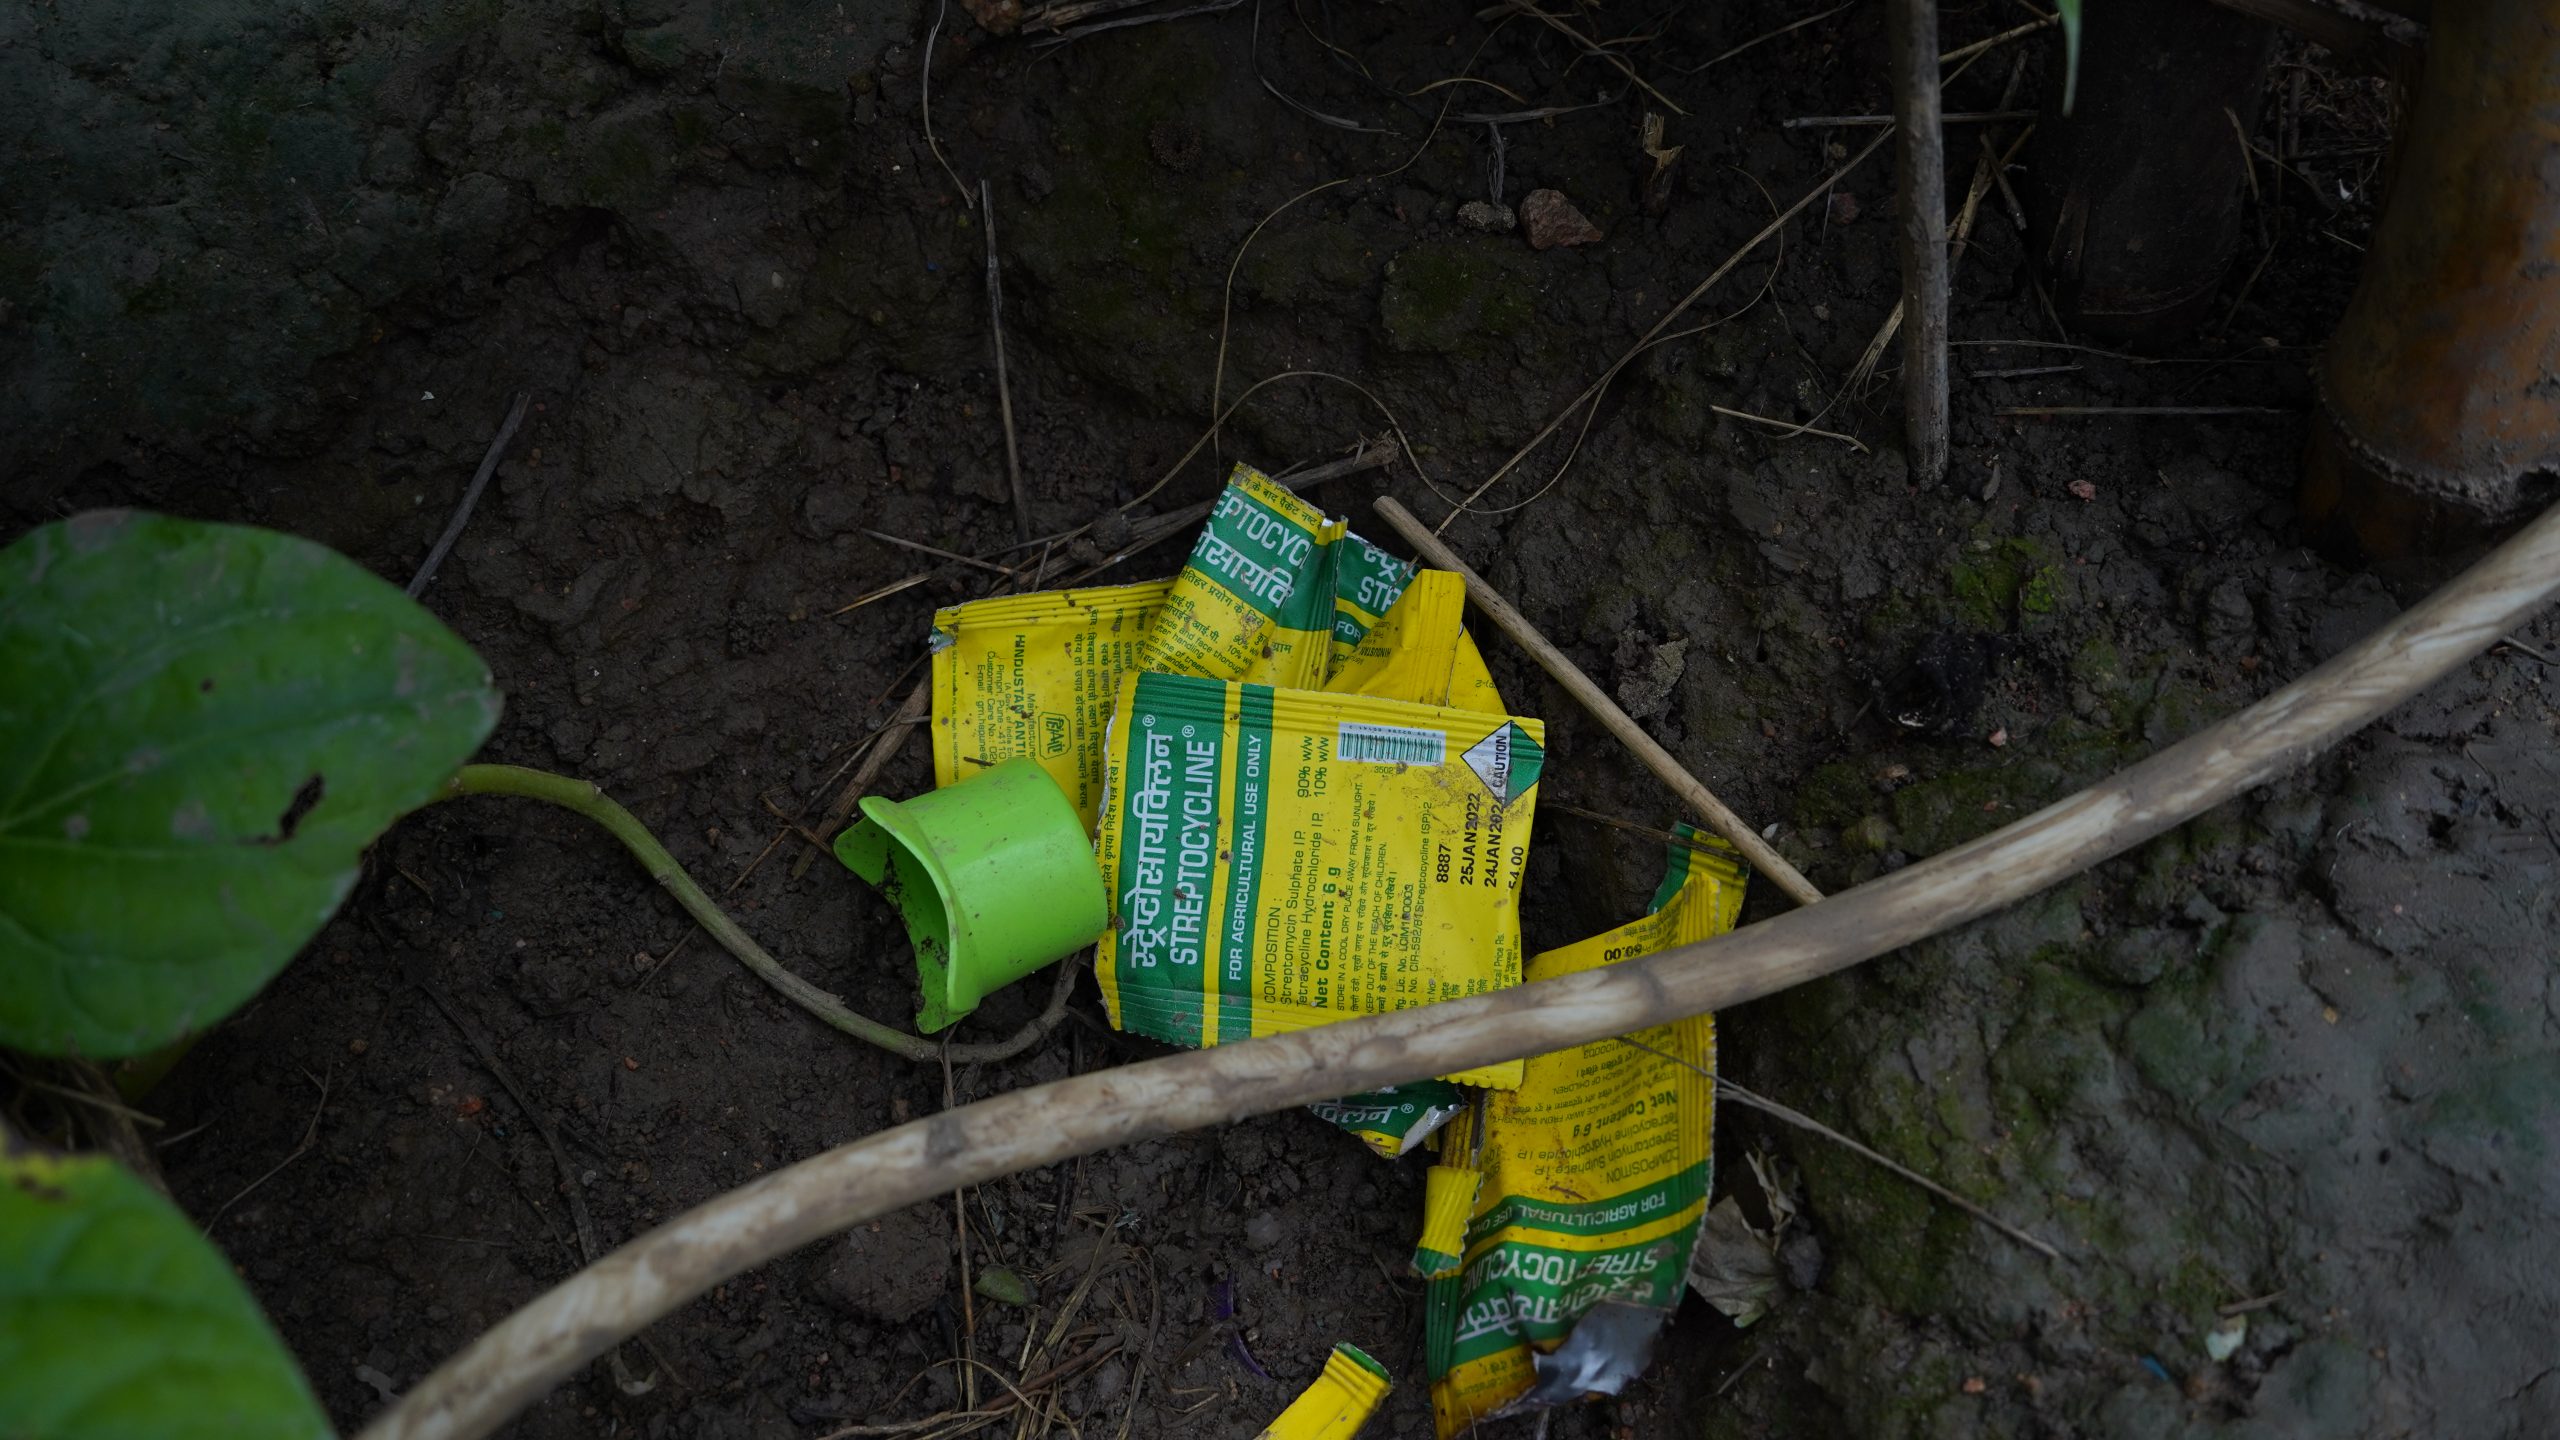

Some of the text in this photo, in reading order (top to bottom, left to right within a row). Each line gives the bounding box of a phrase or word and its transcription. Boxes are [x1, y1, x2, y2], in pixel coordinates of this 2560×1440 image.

[1299, 735, 1313, 761] w/w
[1316, 736, 1330, 762] w/w
[1491, 735, 1508, 788] CAUTION
[1296, 765, 1311, 797] 90%
[1313, 765, 1327, 796] 10%
[1349, 829, 1358, 855] FROM
[1460, 792, 1481, 885] 25JAN2022
[1228, 733, 1262, 980] FOR AGRICULTURAL USE ONLY
[1346, 857, 1355, 881] AWAY
[1435, 843, 1451, 883] 8887
[1286, 849, 1304, 909] Sulphate
[1303, 831, 1322, 924] Hydrochloride
[1343, 884, 1353, 912] PLACE
[1341, 913, 1350, 933] DRY
[1370, 905, 1380, 935] REACH
[1313, 866, 1340, 1008] Net Content 6 g
[1368, 938, 1377, 956] THE
[1263, 906, 1281, 1003] COMPOSITION
[1279, 913, 1297, 1005] Streptomycin
[1297, 929, 1312, 1006] Tetracycline
[1338, 961, 1346, 969] A
[1367, 958, 1376, 969] OF
[1397, 955, 1407, 972] No.
[1493, 947, 1503, 966] Price
[1337, 972, 1345, 980] IN
[1365, 973, 1375, 990] OUT
[1335, 983, 1346, 1011] STORE
[1364, 992, 1374, 1013] KEEP
[1596, 1100, 1645, 1129] Content
[1518, 1202, 1638, 1226] AGRICULTURAL
[1641, 1192, 1666, 1213] FOR
